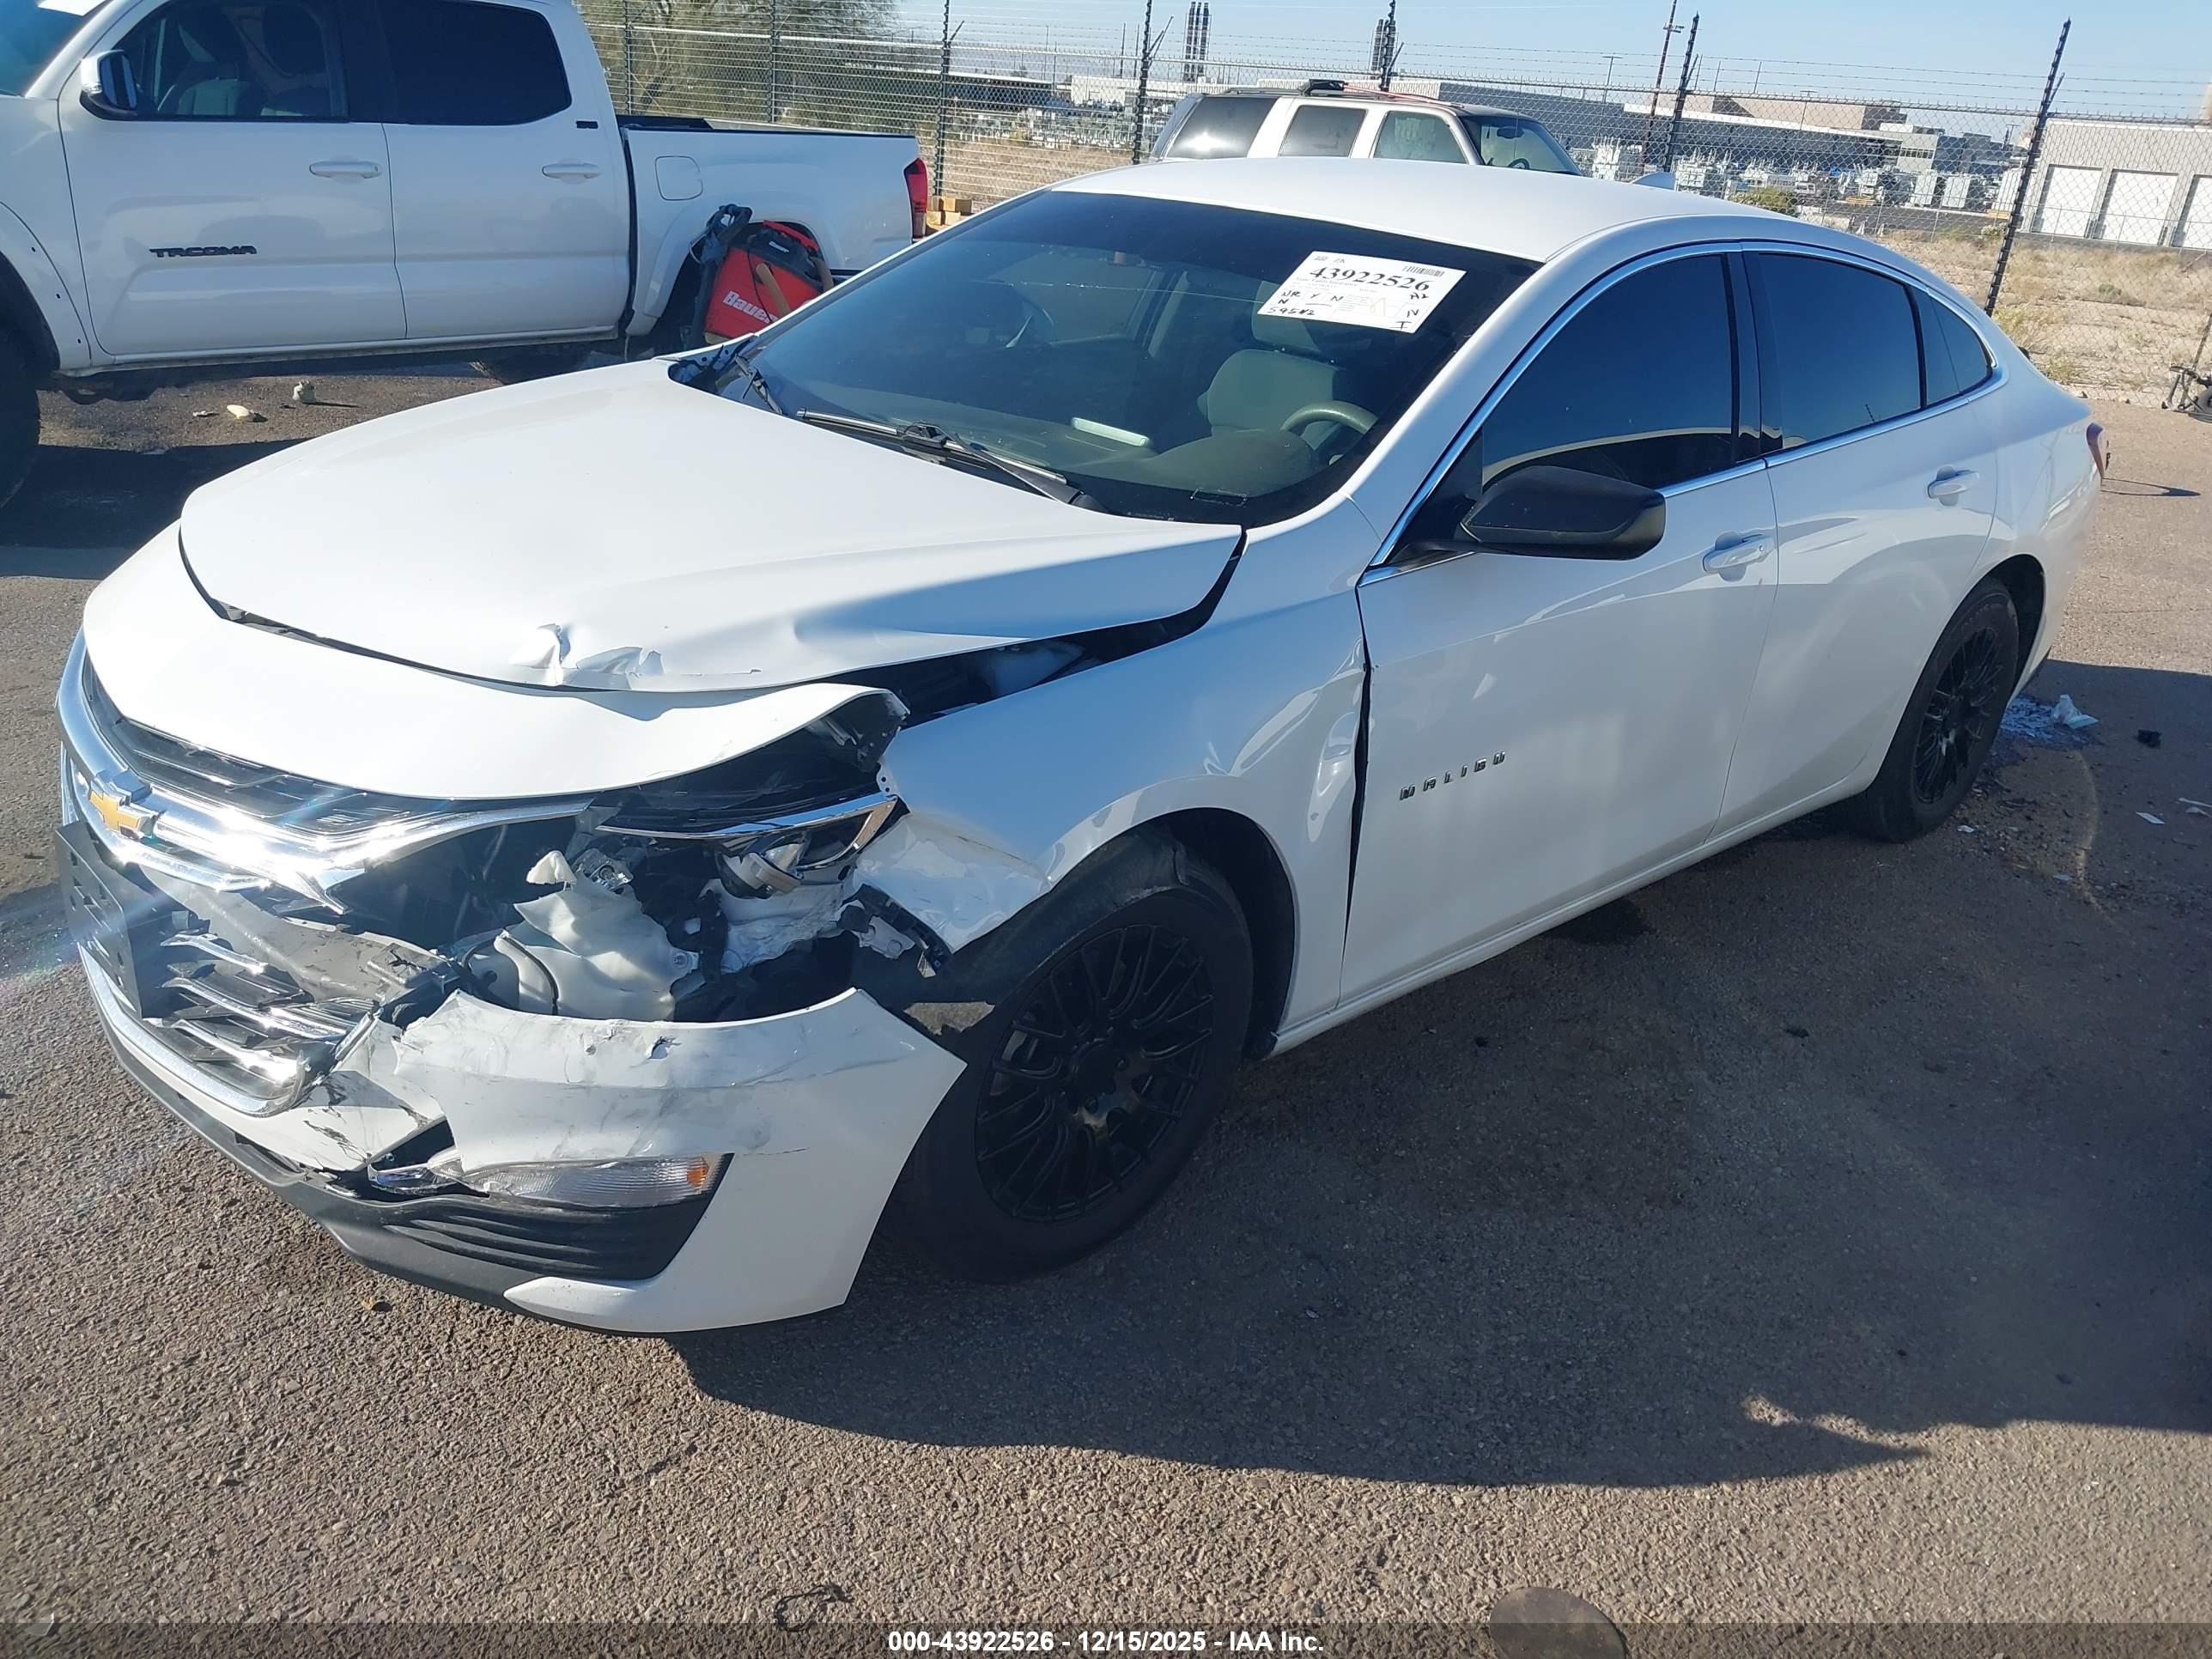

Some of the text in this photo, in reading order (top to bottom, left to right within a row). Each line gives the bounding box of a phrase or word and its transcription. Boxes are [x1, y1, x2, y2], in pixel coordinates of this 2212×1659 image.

[149, 245, 258, 258] TACOMA
[1310, 266, 1431, 292] 43922526
[1399, 751, 1506, 801] MALIBU
